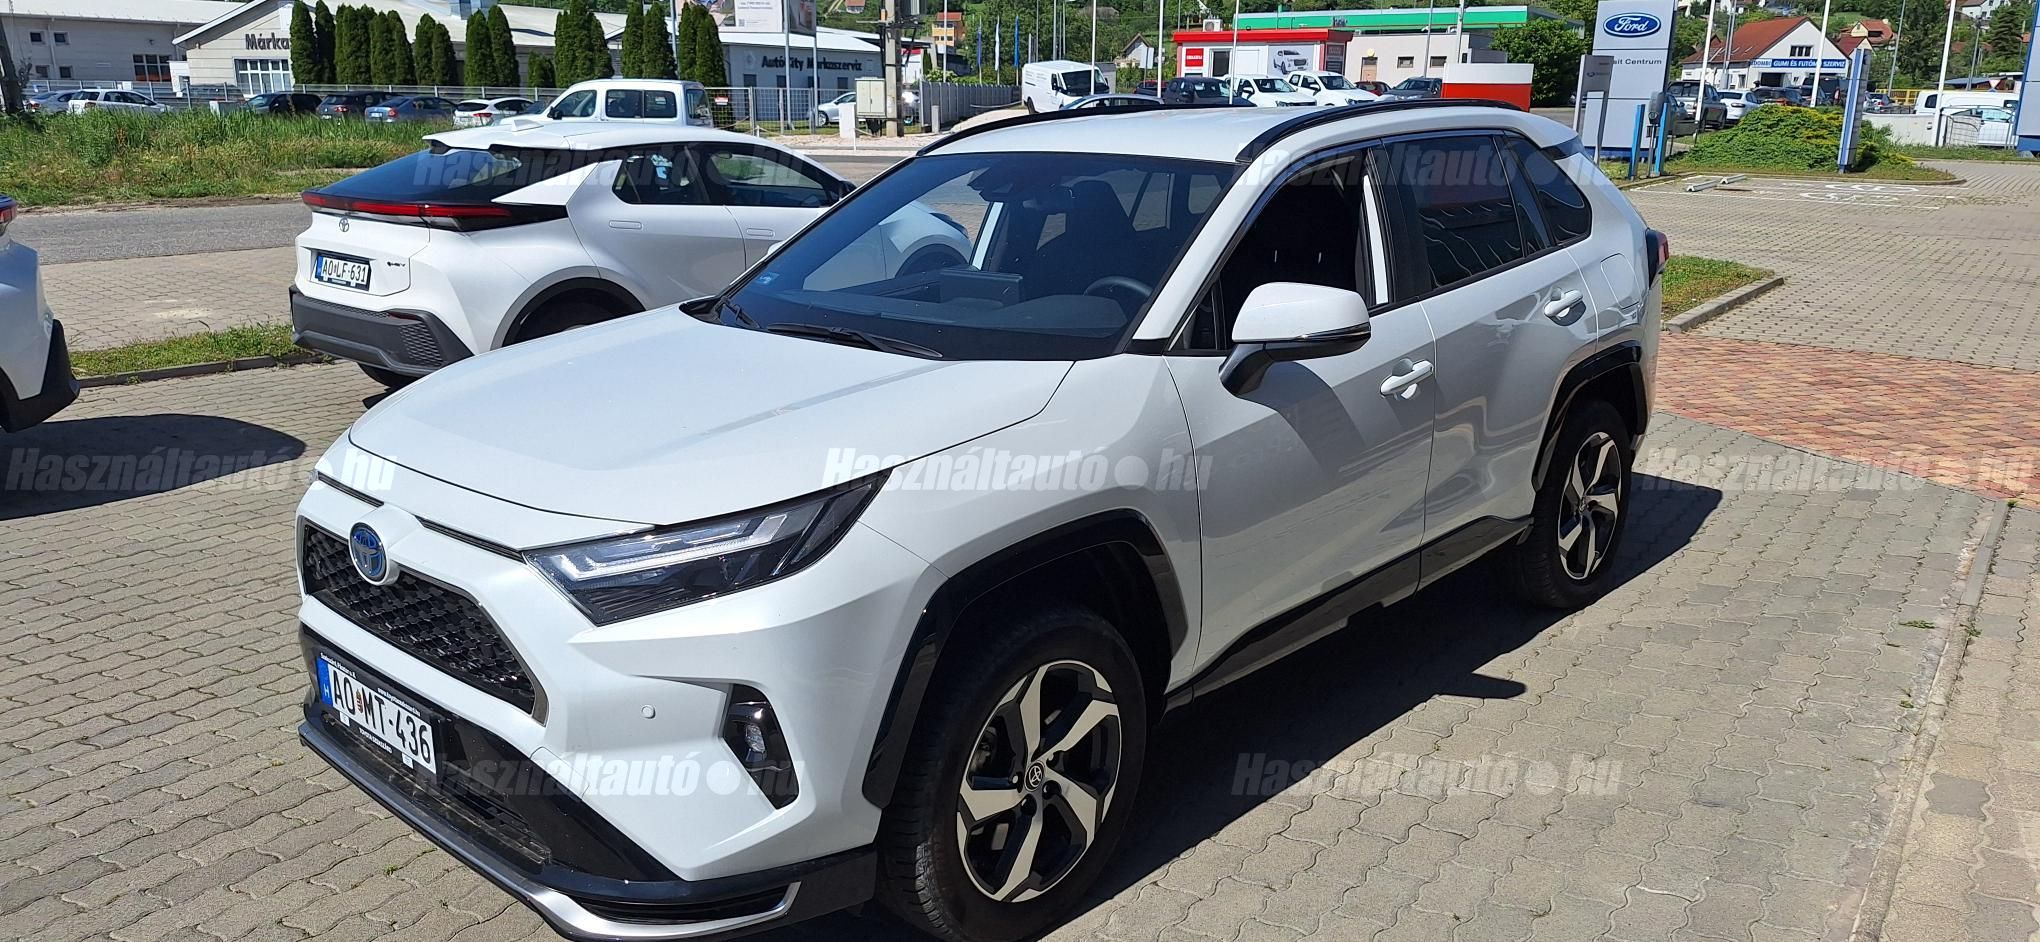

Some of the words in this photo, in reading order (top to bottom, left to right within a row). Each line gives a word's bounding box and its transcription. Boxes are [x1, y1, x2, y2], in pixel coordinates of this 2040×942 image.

[1614, 17, 1650, 32] Ford
[761, 55, 804, 71] Autóity
[806, 56, 862, 71] Mrkaszerviz
